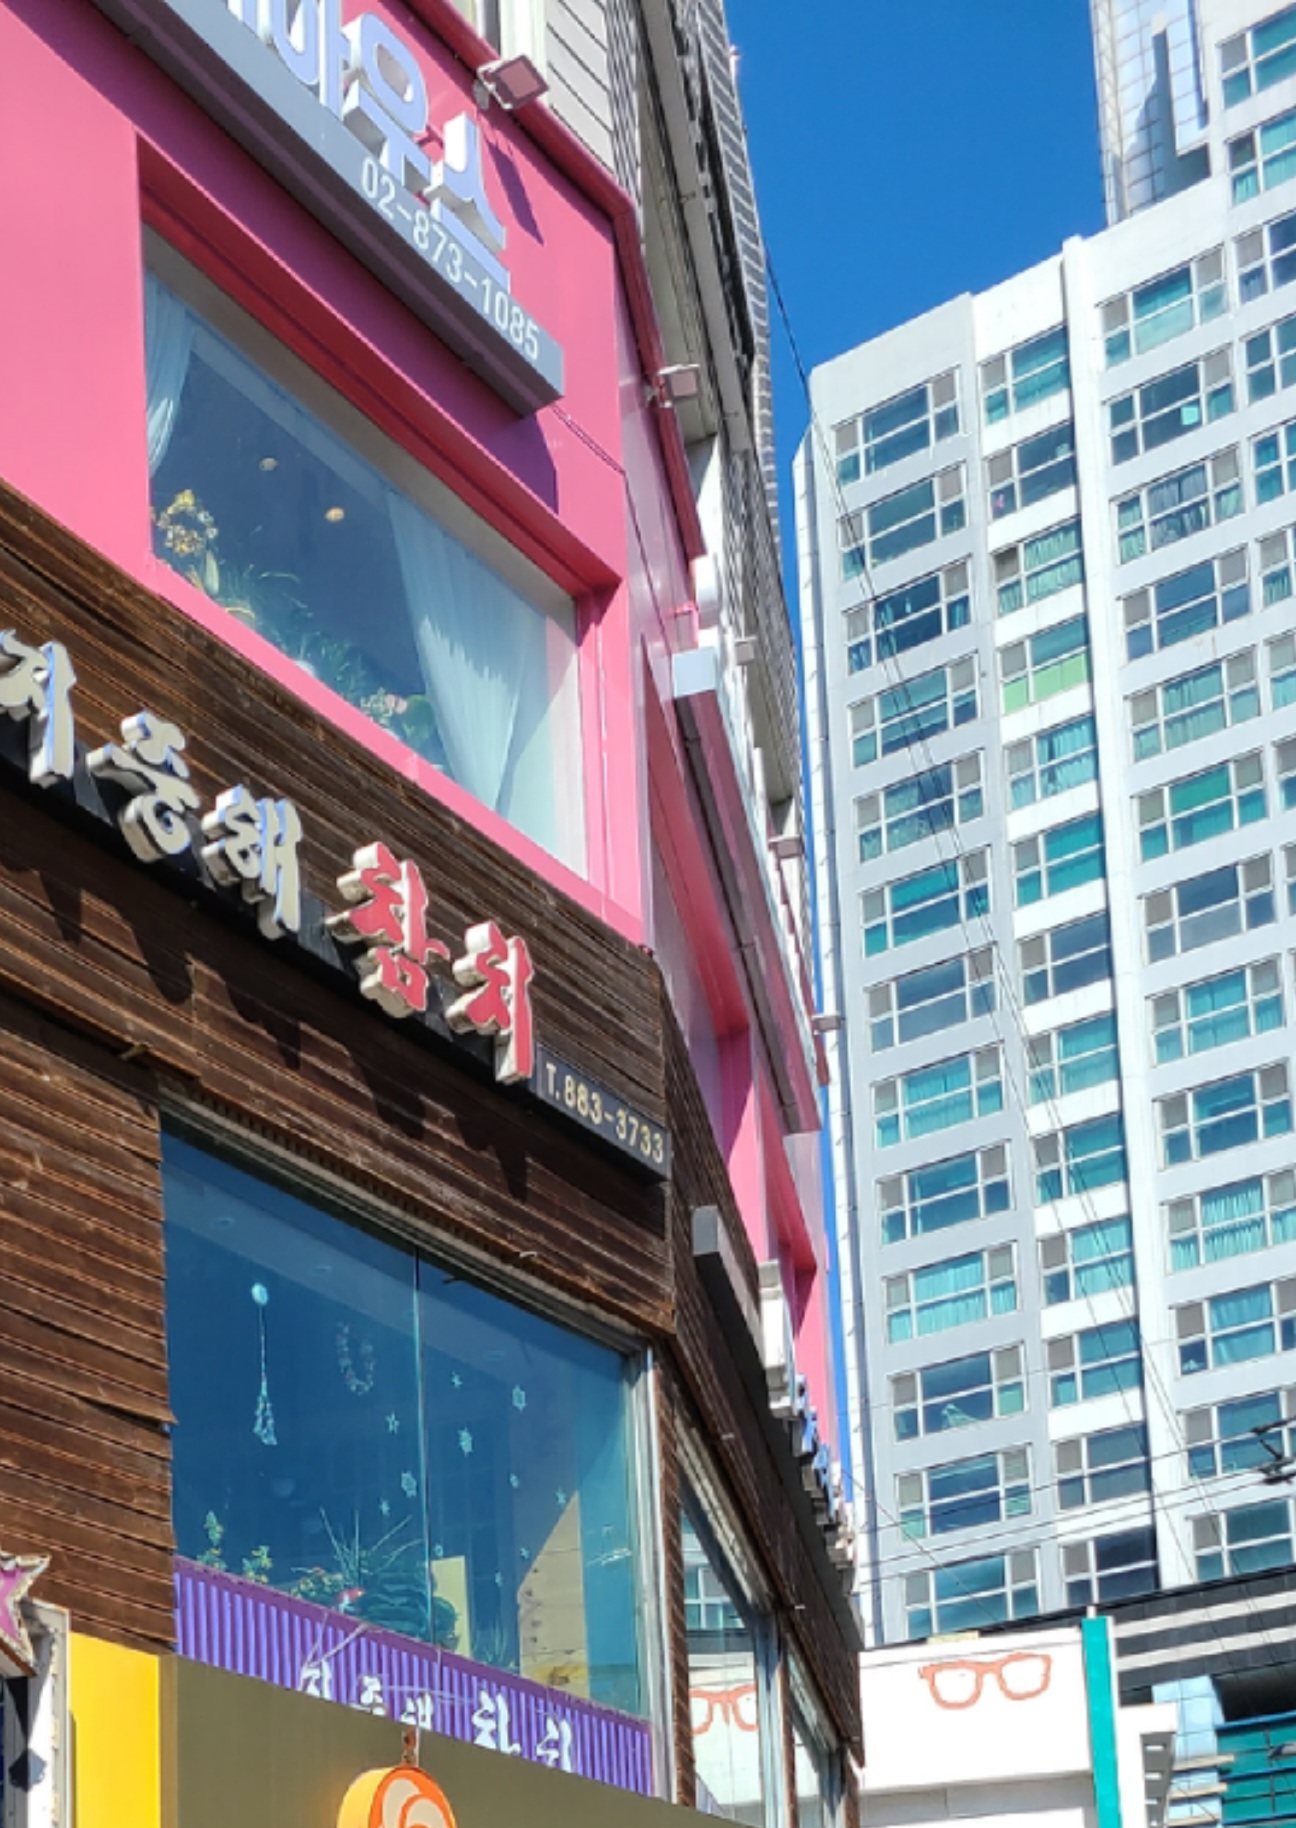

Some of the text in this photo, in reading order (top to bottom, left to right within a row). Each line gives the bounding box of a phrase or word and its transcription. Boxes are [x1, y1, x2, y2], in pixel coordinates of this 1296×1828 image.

[362, 157, 540, 361] 02-873-1085
[326, 841, 534, 1083] 참치
[545, 1062, 664, 1164] T.883-3733
